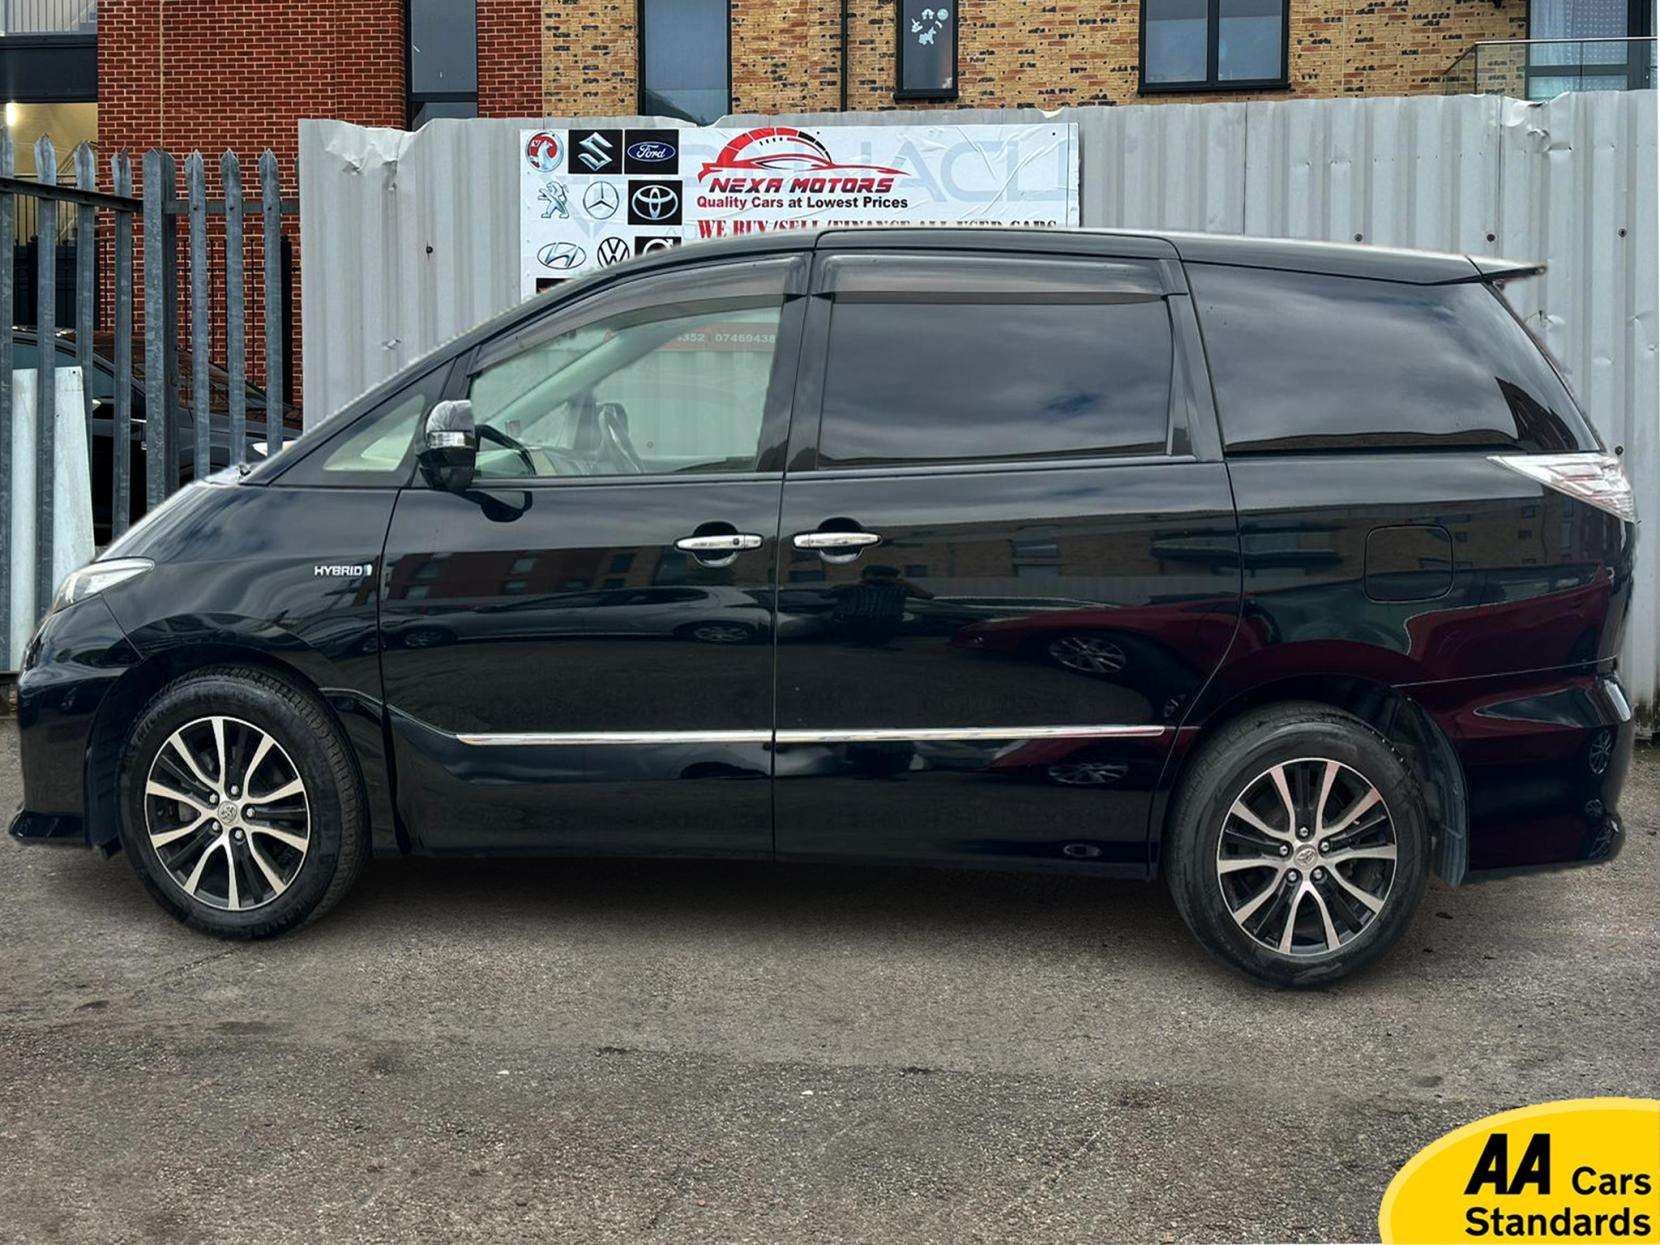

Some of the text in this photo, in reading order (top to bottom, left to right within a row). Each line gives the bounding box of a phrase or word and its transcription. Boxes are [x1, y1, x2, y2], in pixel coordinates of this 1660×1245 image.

[636, 144, 666, 159] Ford
[709, 178, 894, 194] NEXA MOTORS
[697, 195, 908, 210] Quality Cars at Lowest Prices
[314, 565, 363, 577] HYBRID
